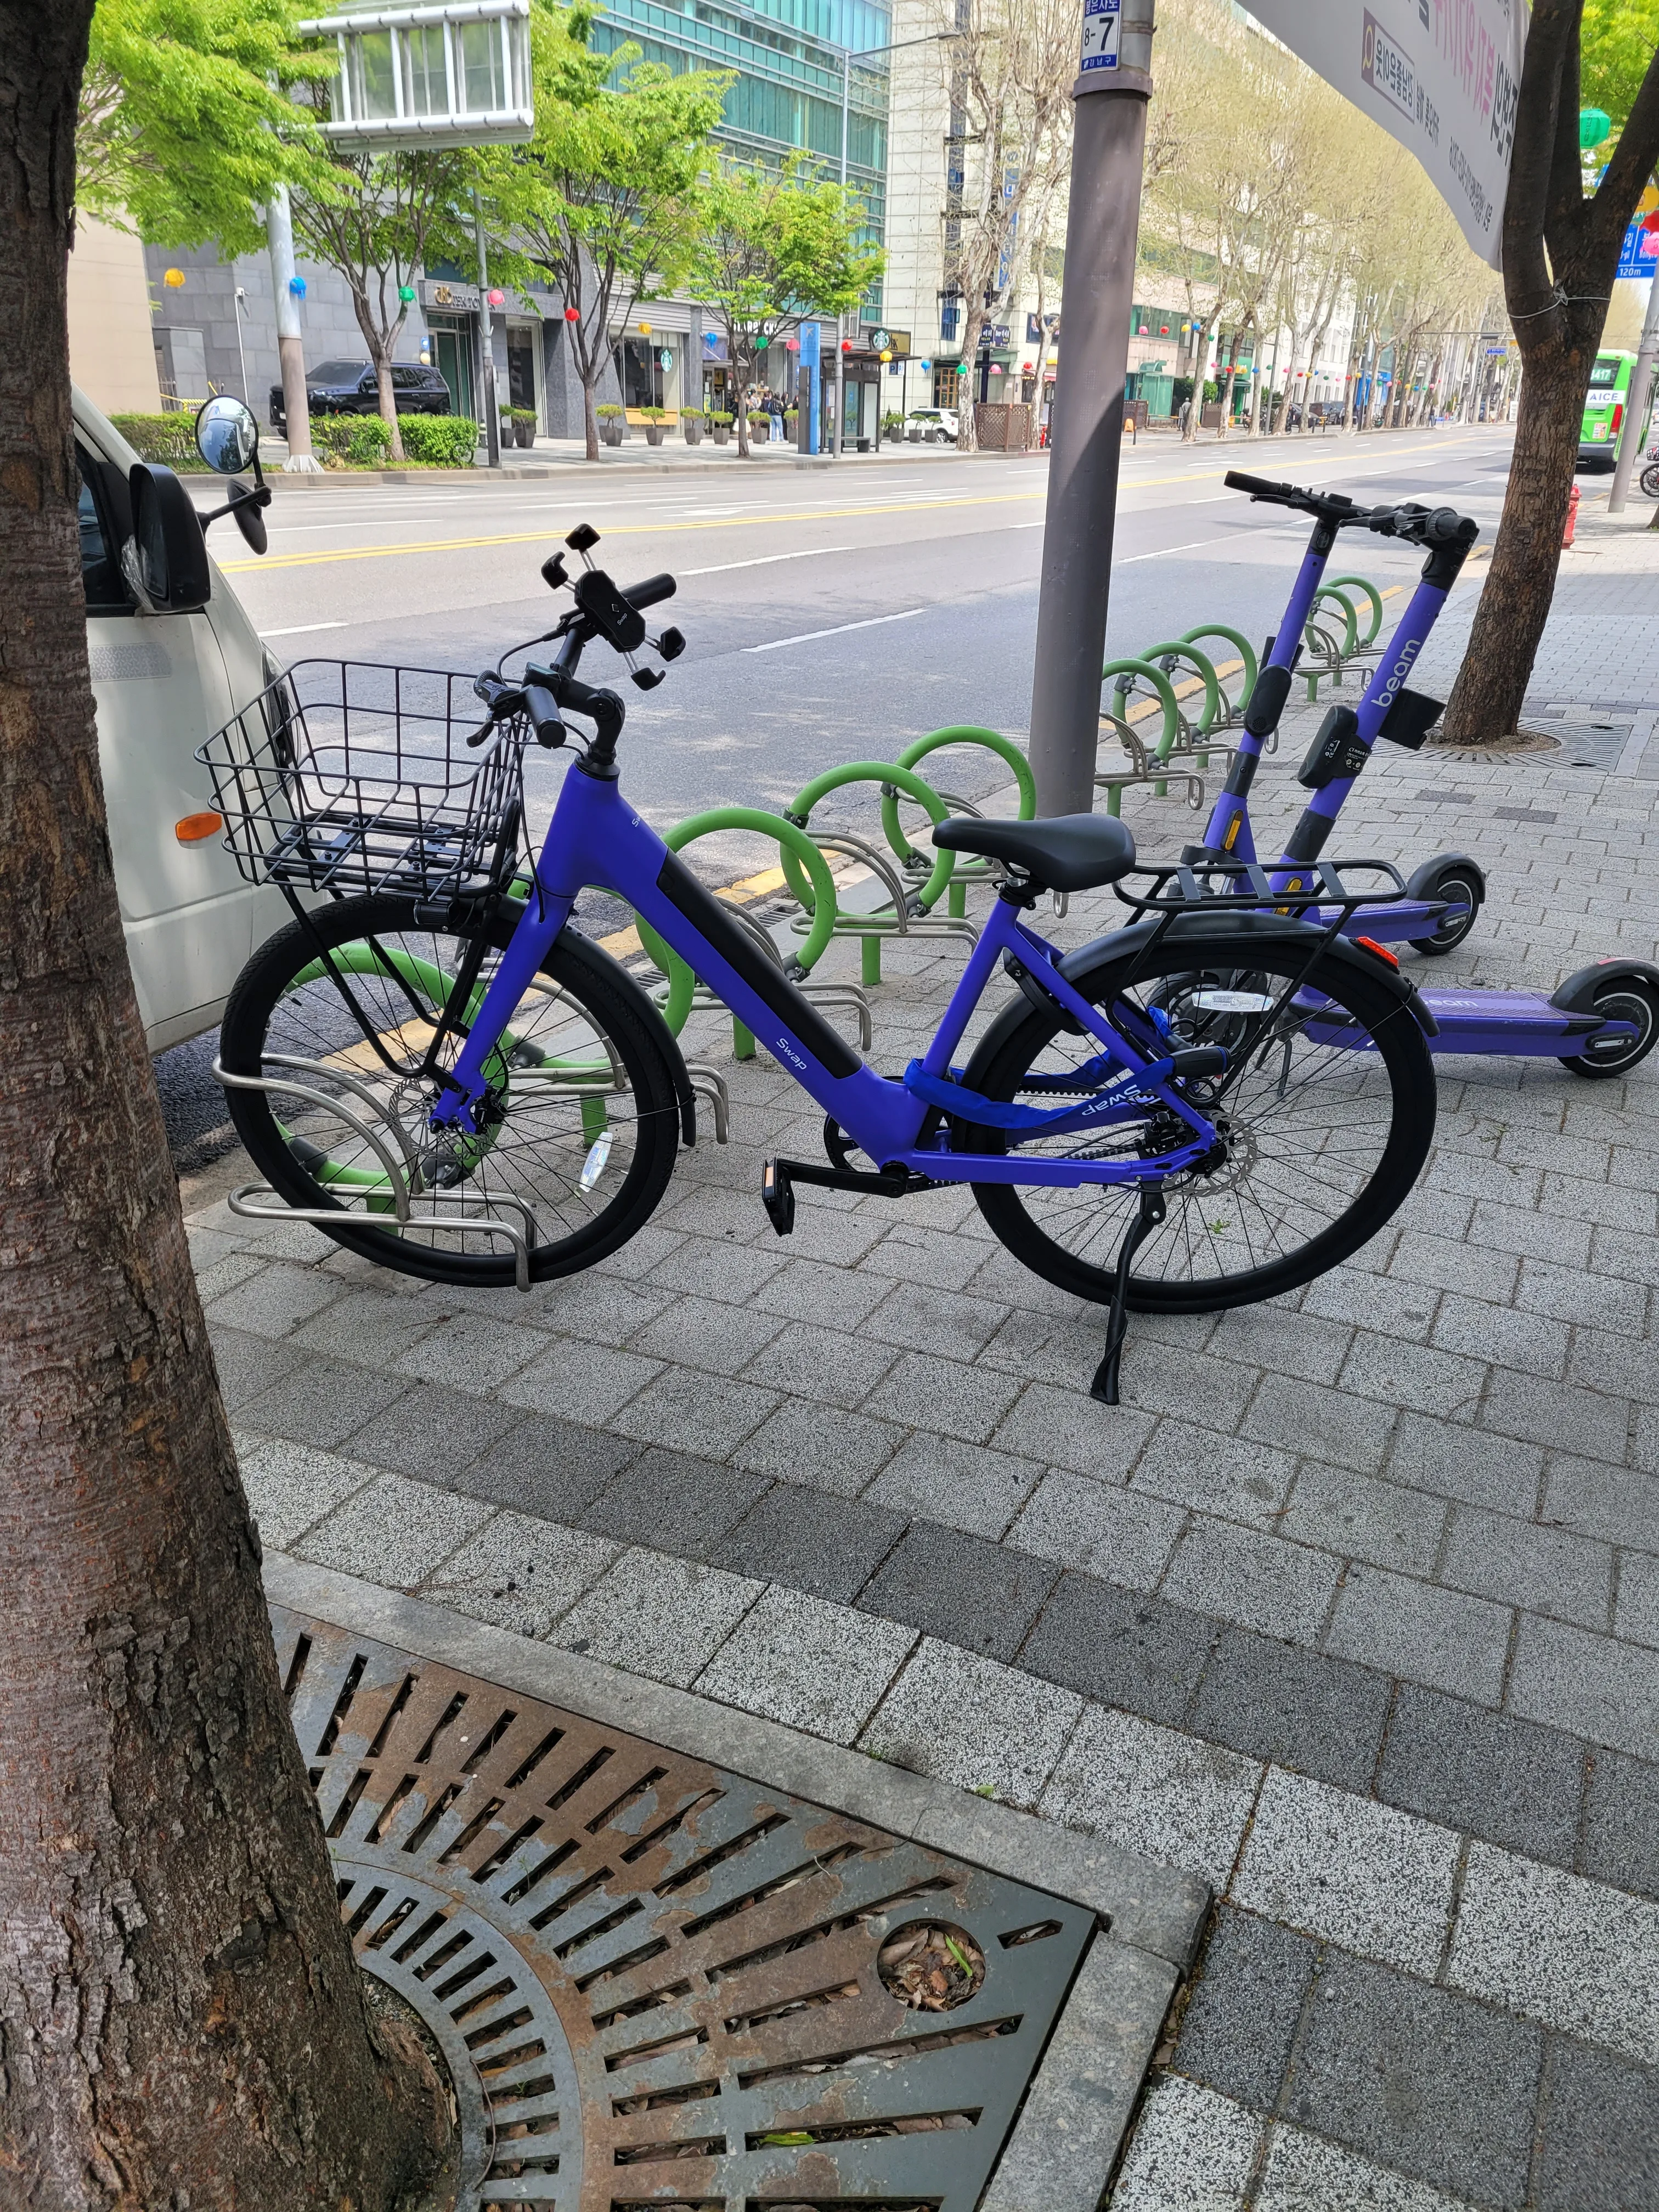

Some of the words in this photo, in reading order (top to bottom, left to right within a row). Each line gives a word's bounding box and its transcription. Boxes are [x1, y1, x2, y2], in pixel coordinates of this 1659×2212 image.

[1620, 267, 1641, 276] 120m
[617, 613, 628, 625] Swap
[1370, 639, 1421, 707] beam
[776, 1038, 807, 1070] Swap
[1081, 1084, 1141, 1116] Swap
